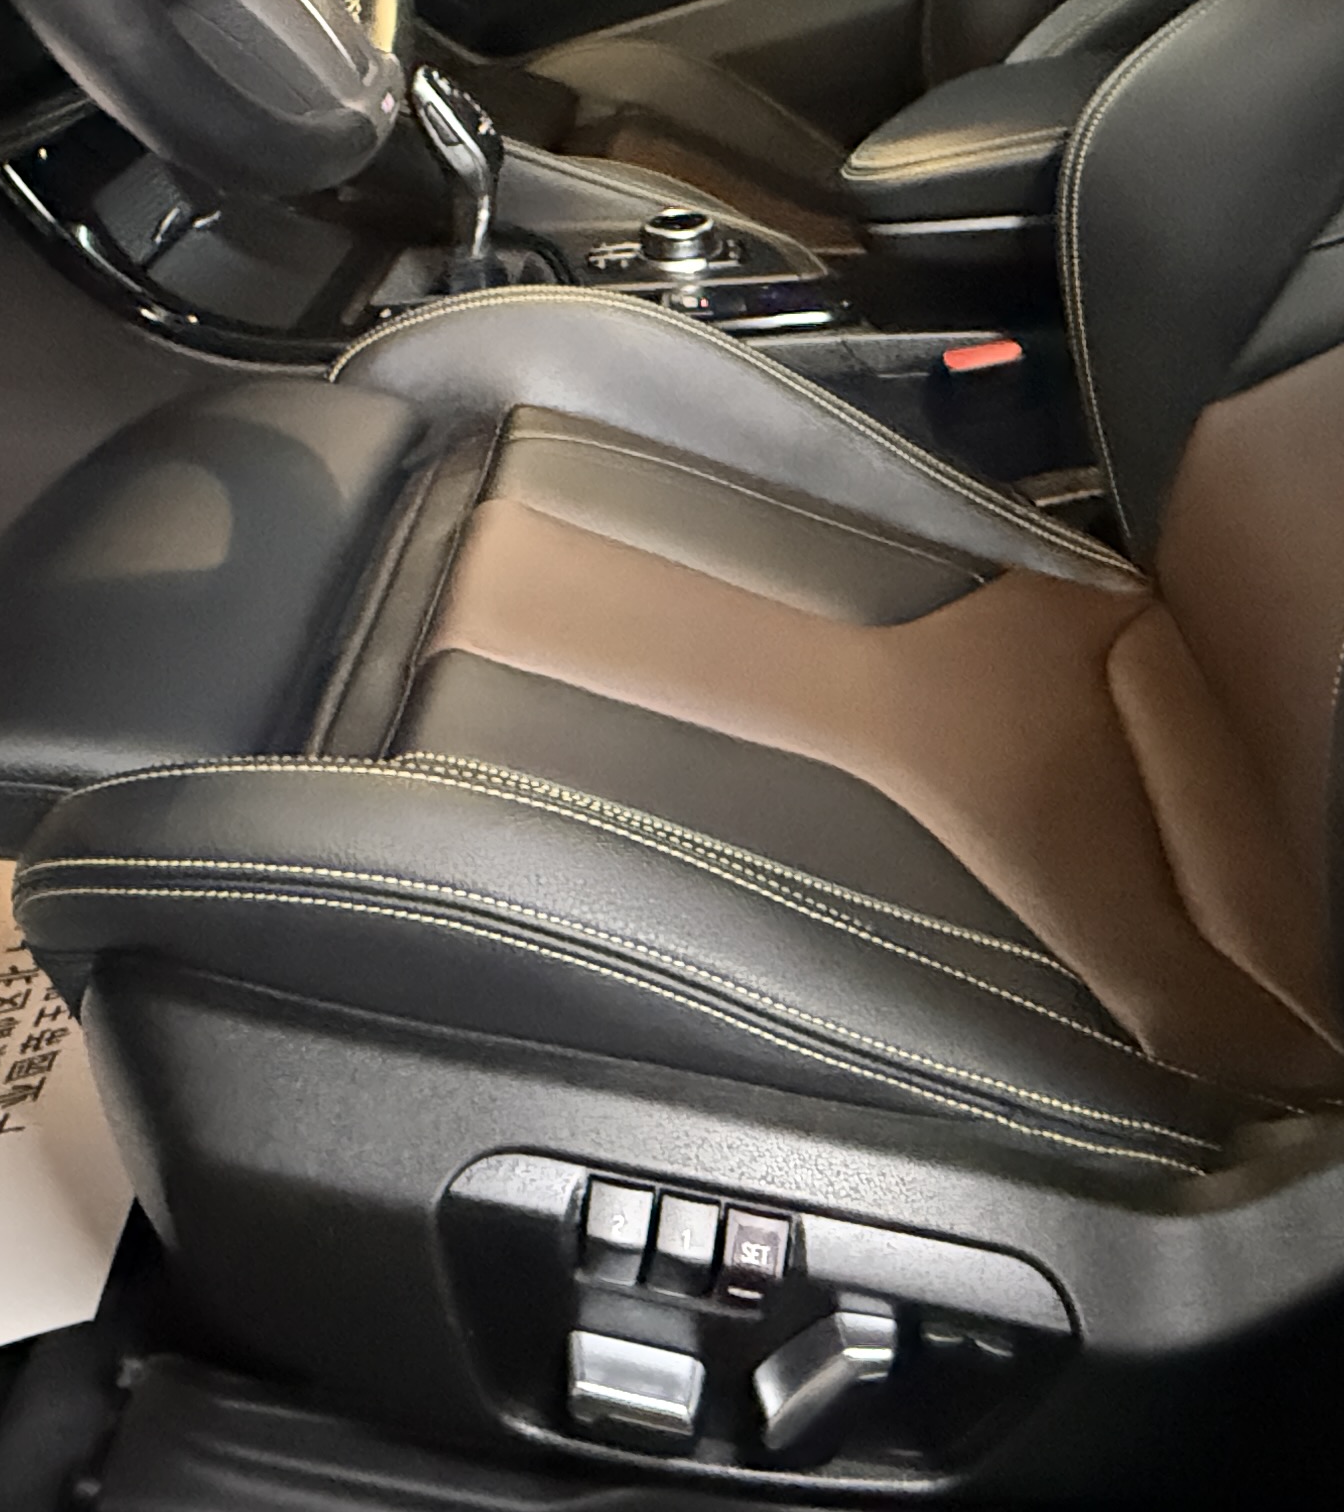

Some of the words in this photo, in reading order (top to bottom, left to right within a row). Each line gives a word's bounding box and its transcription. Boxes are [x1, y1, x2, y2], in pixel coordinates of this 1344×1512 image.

[611, 1213, 626, 1236] 2
[681, 1228, 692, 1251] 1
[740, 1240, 771, 1265] SET
